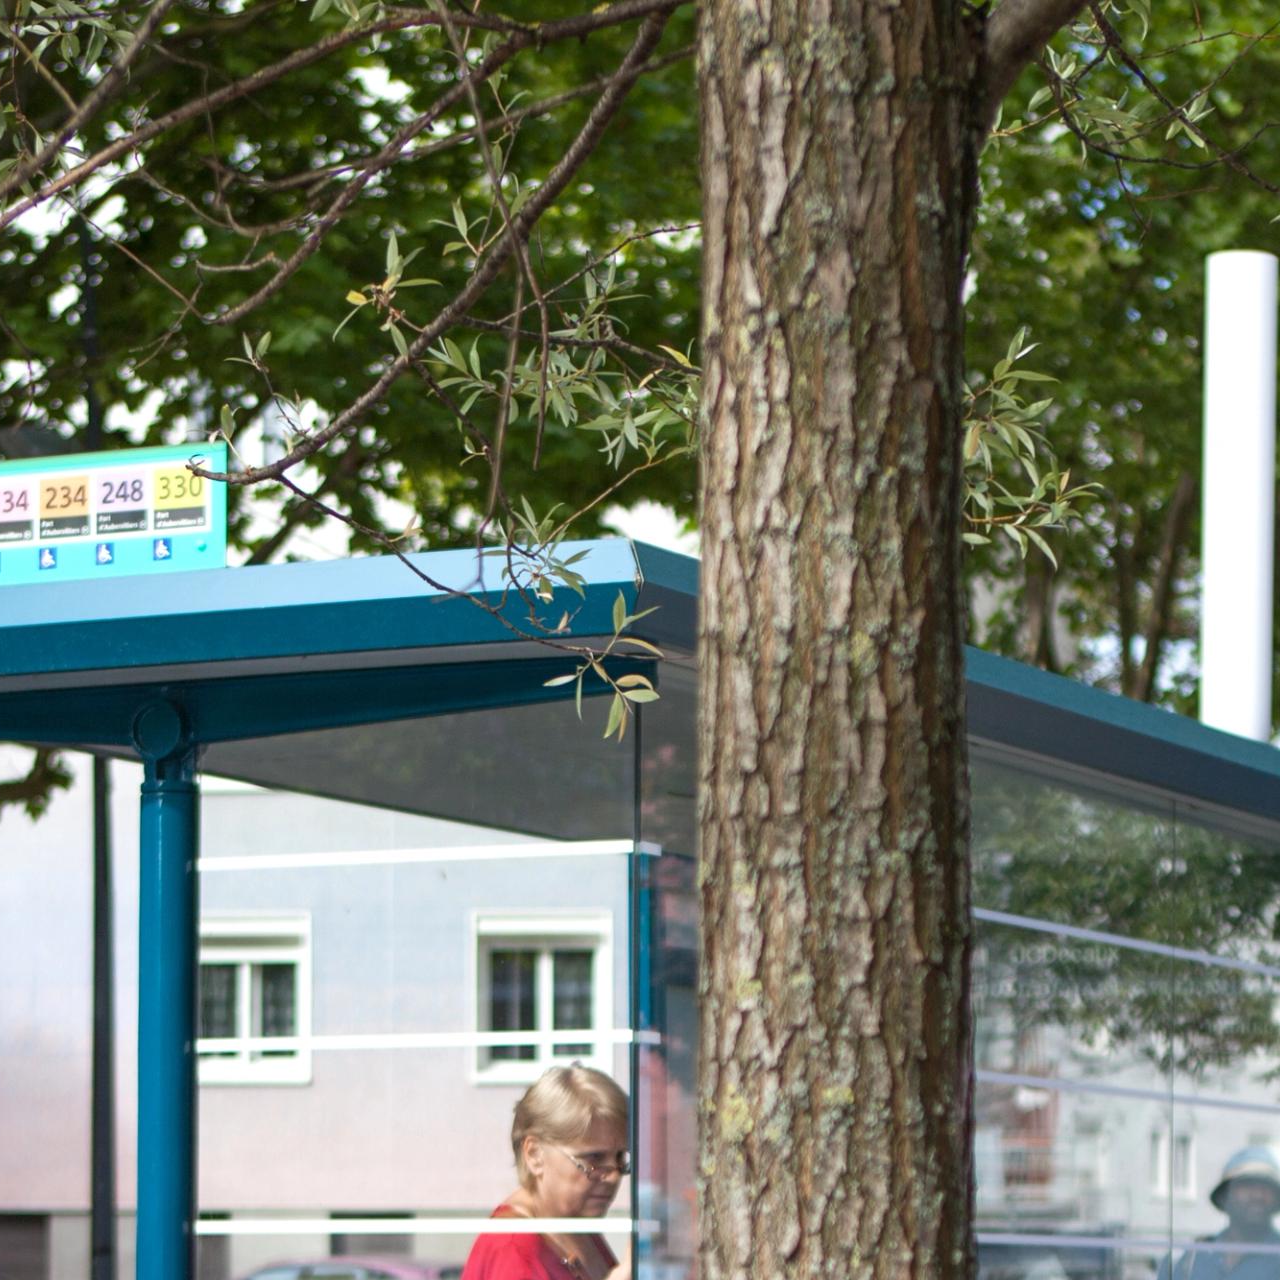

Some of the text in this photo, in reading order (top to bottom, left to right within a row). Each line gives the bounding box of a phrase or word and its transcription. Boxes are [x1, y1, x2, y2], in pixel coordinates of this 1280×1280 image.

[45, 484, 88, 510] 234
[101, 479, 144, 505] 248
[158, 474, 203, 500] 330
